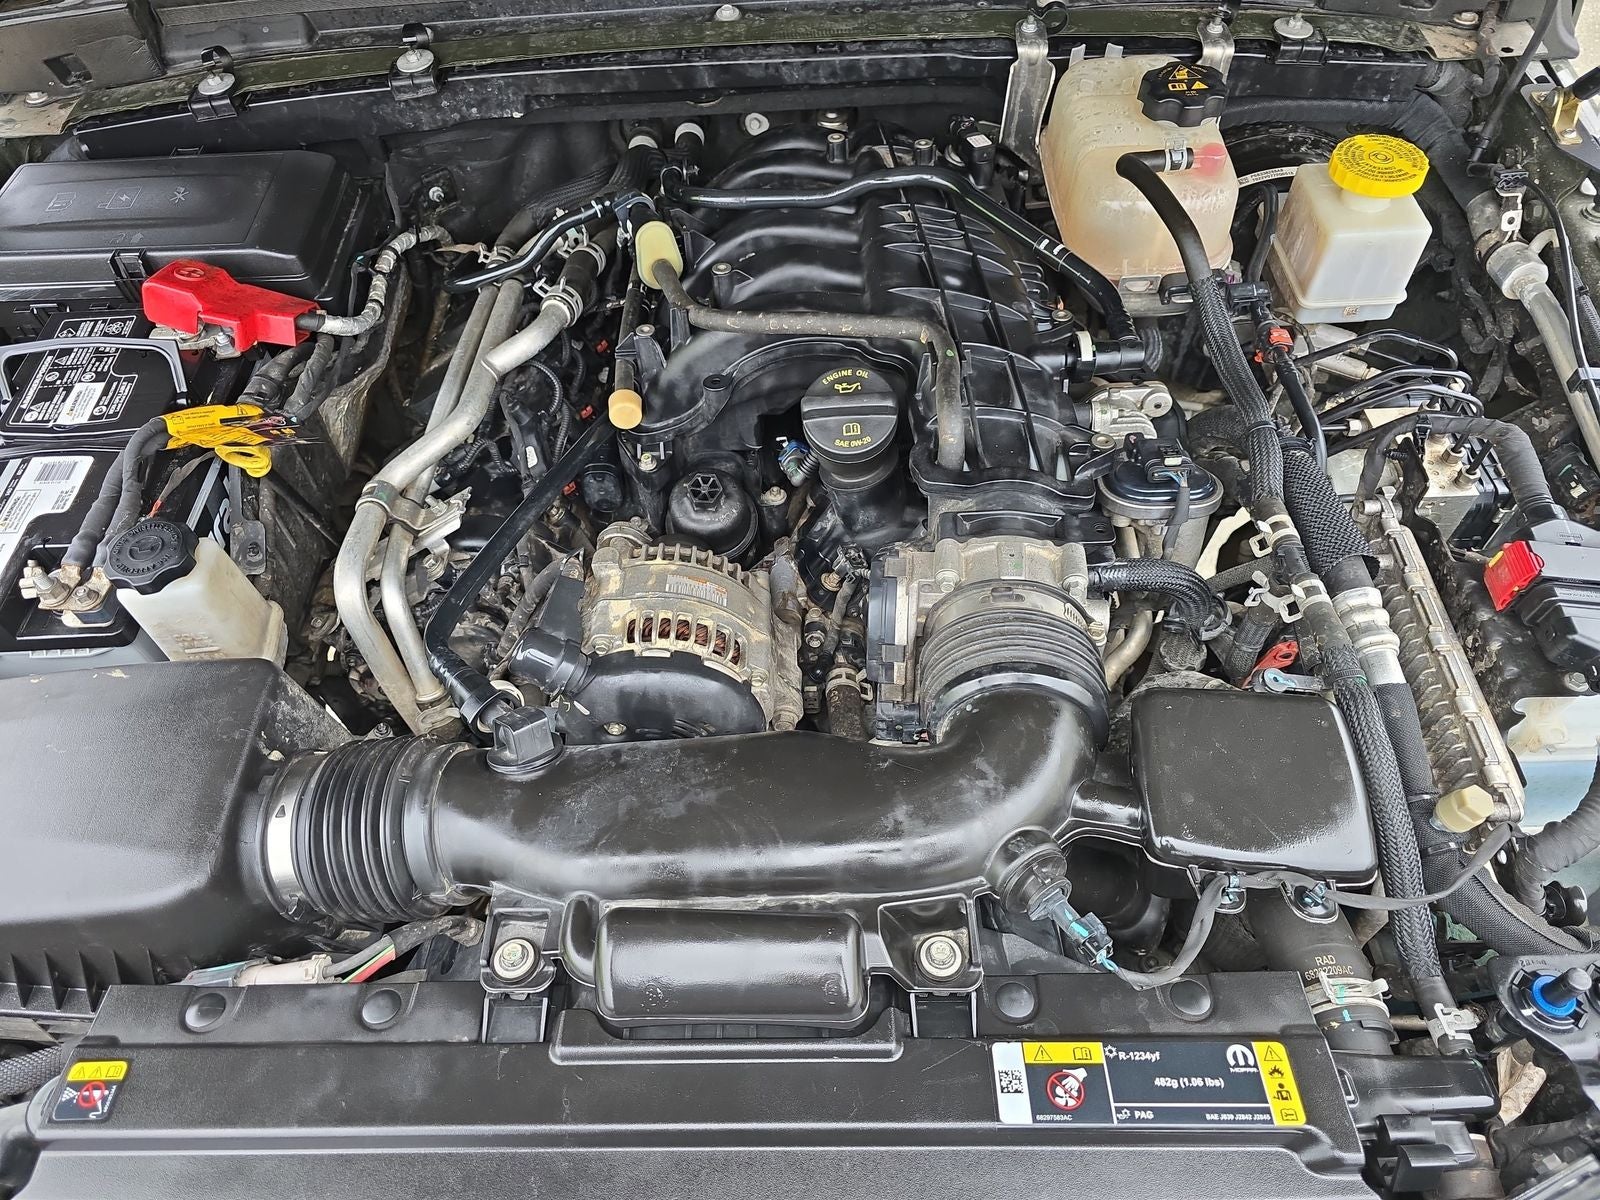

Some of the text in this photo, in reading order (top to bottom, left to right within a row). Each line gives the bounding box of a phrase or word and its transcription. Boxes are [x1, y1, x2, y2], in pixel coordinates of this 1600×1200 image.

[822, 369, 870, 385] ENGINE OIL
[834, 438, 850, 448] SAE
[1314, 954, 1336, 966] RAD
[1118, 1051, 1161, 1063] R-1234yf
[1180, 1077, 1204, 1090] (1.06
[1205, 1077, 1225, 1089] lbs)
[1133, 1110, 1155, 1120] PAG
